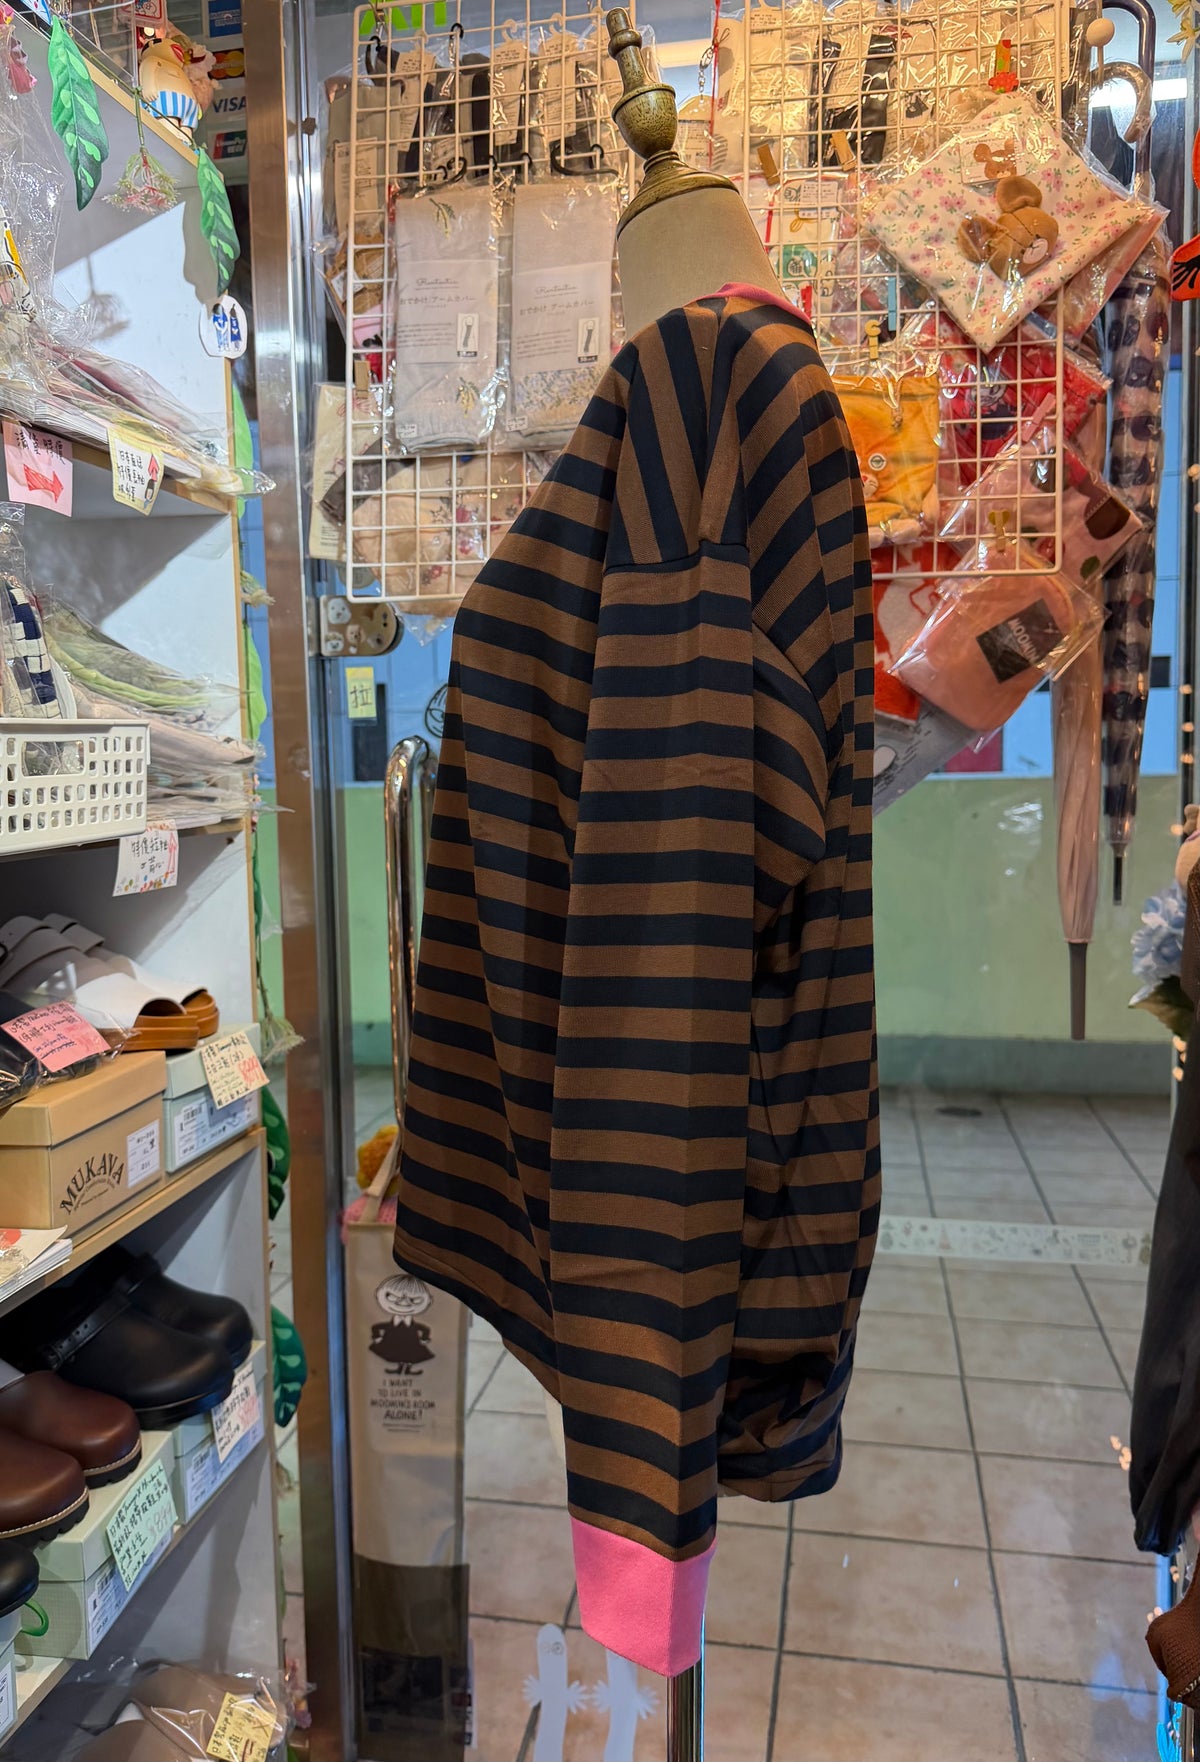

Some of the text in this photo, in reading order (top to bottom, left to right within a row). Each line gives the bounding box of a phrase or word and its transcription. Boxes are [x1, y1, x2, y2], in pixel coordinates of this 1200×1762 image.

[213, 97, 246, 113] VISA
[1007, 617, 1040, 663] MOOMIN
[349, 684, 373, 709] 拉
[59, 1152, 125, 1216] MUKAVA
[390, 1378, 413, 1387] WANT
[377, 1388, 422, 1398] TO LIVE IN
[413, 1399, 435, 1410] ROOM
[384, 1409, 423, 1421] ALONE!
